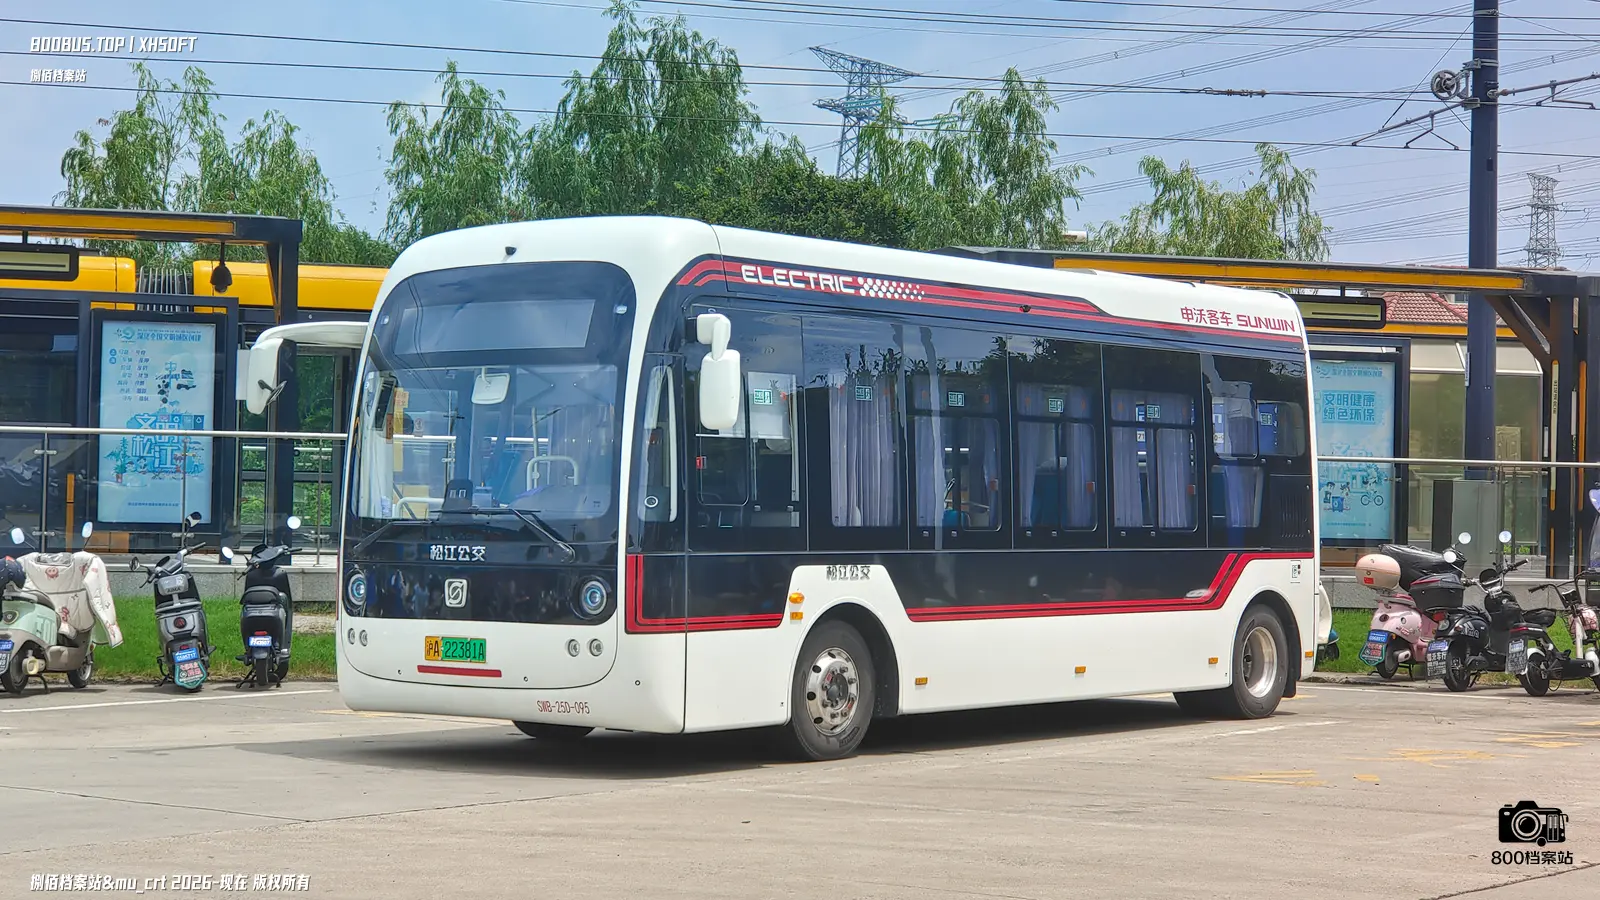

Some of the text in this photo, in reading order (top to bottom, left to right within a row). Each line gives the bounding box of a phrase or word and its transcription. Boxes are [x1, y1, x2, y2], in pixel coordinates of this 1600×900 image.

[741, 264, 855, 294] ELECTRIC
[1180, 306, 1295, 332] 申沃客车 SUNWIN
[1323, 392, 1375, 407] 文明健康
[1323, 407, 1375, 421] 绿色环保
[132, 434, 180, 468] 松江
[430, 544, 486, 561] 松江公交
[826, 565, 871, 580] 松江公交
